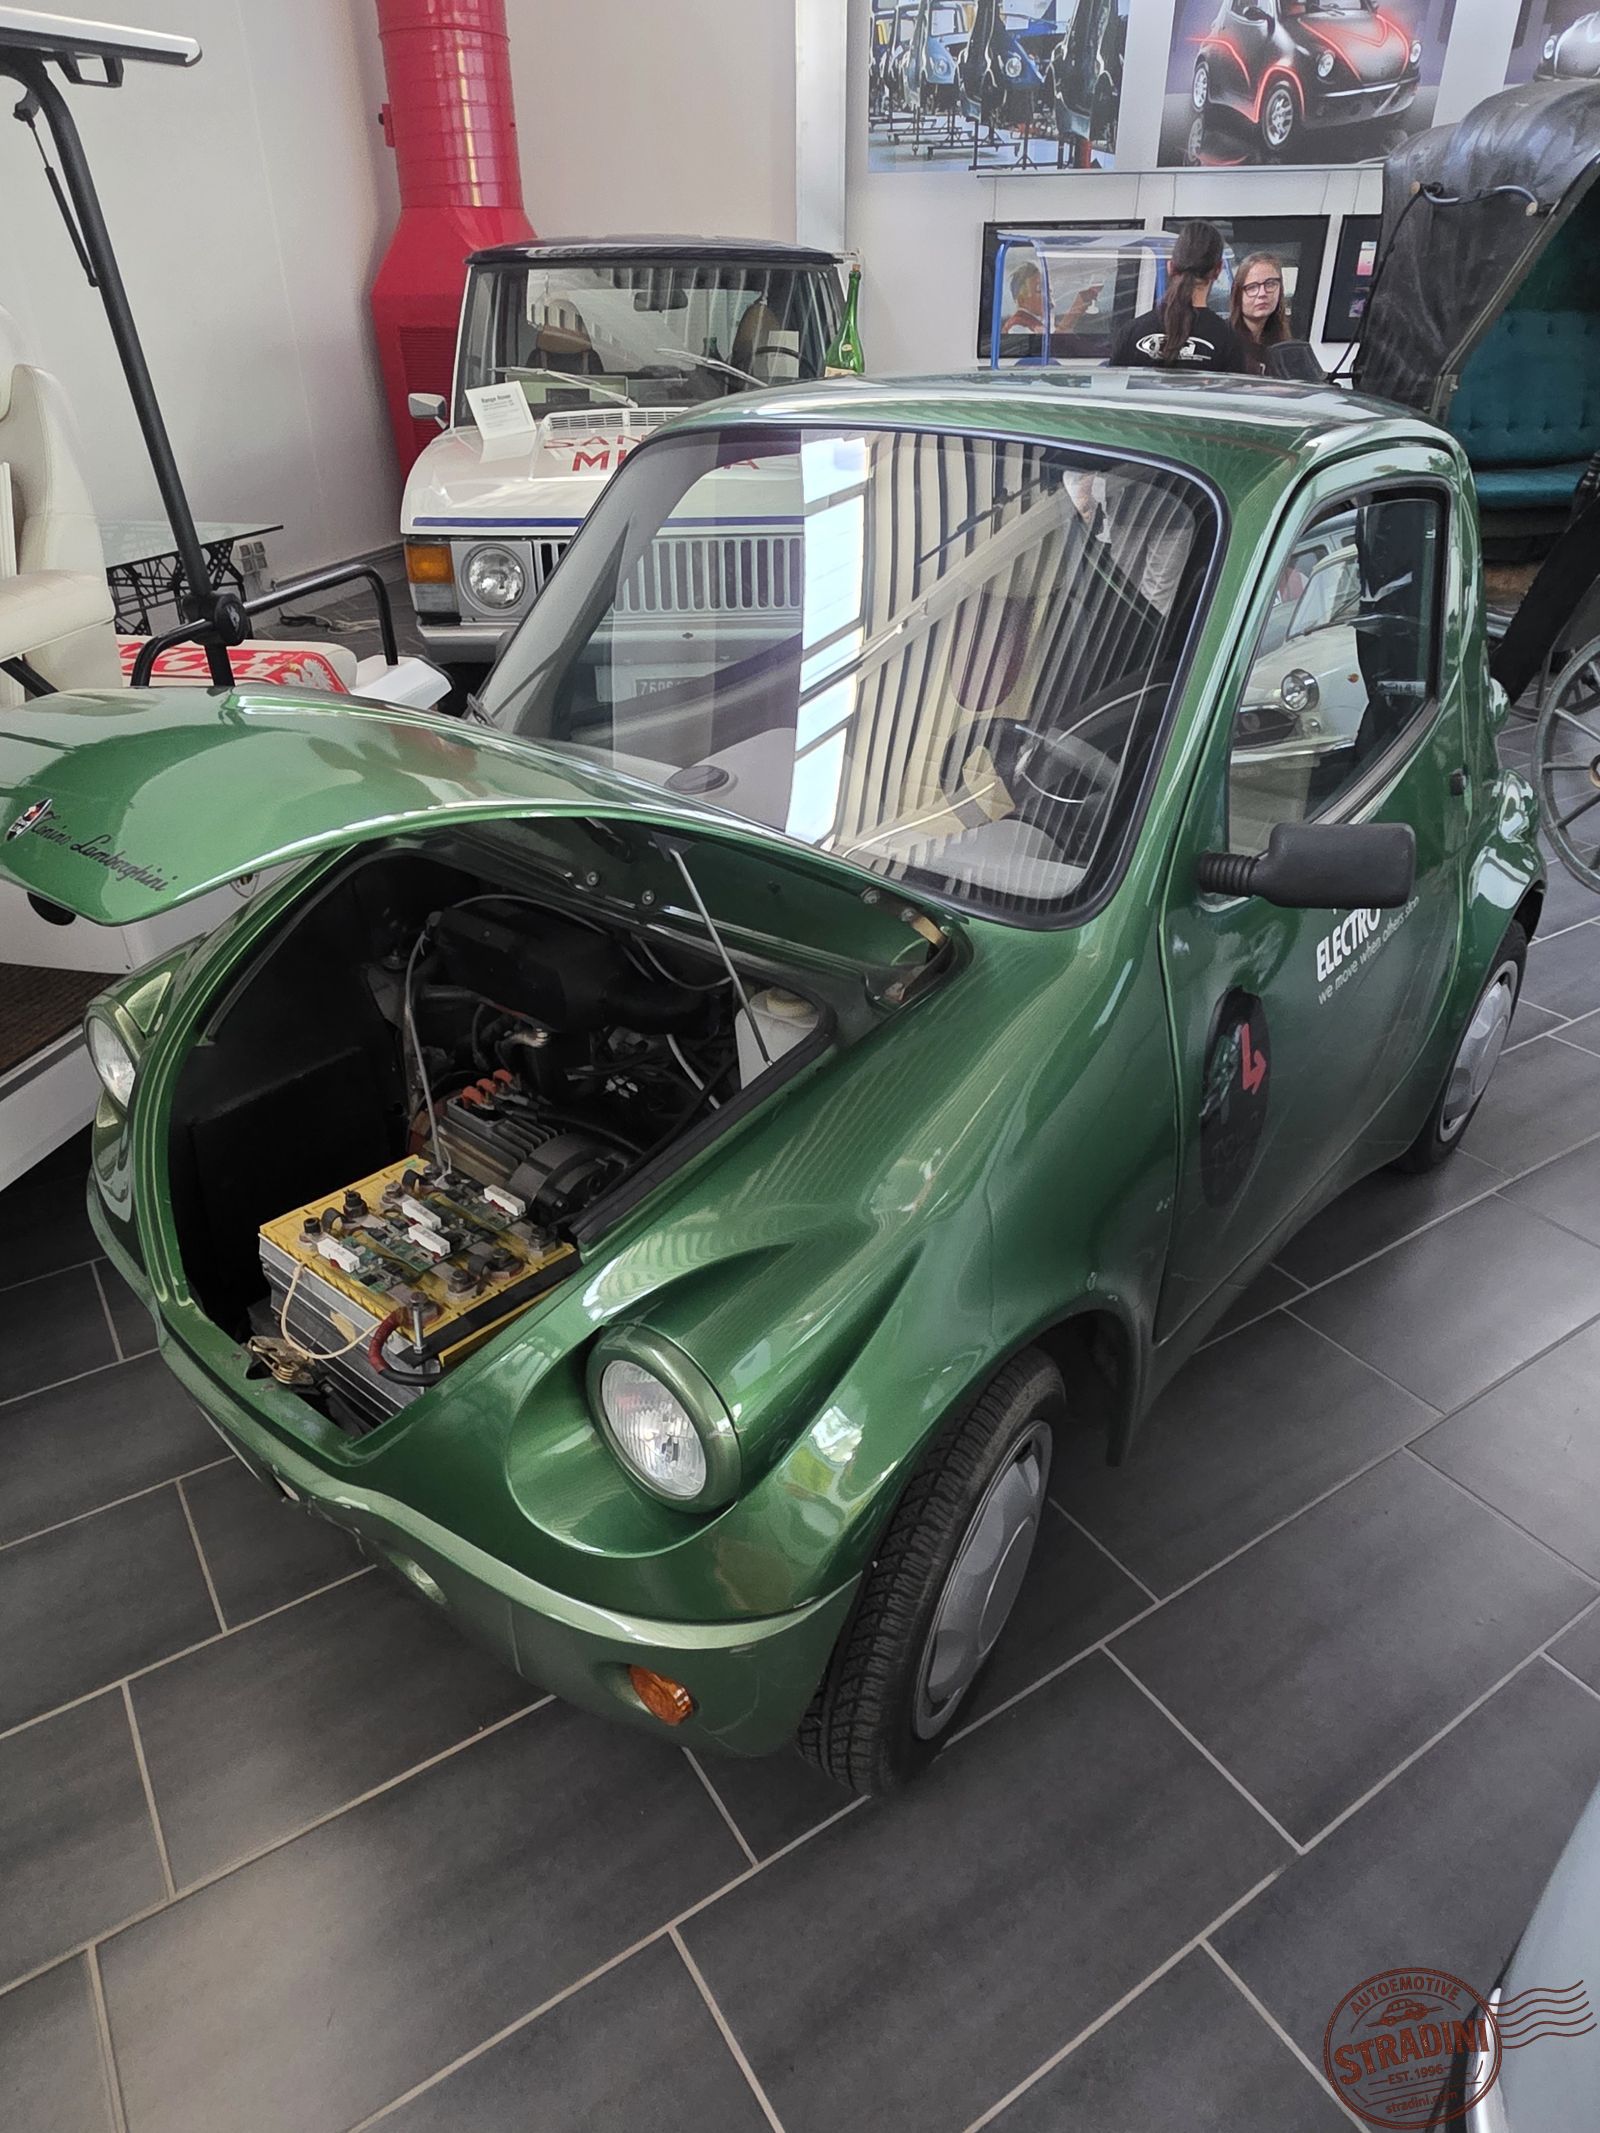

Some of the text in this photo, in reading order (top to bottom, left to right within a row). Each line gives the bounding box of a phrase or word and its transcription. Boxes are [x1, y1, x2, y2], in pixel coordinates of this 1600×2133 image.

[70, 834, 178, 892] Lamborghini
[1316, 908, 1381, 982] ELECTRO
[1318, 984, 1333, 1005] we
[1335, 960, 1358, 990] move
[1360, 936, 1381, 964] when
[1382, 911, 1405, 942] others
